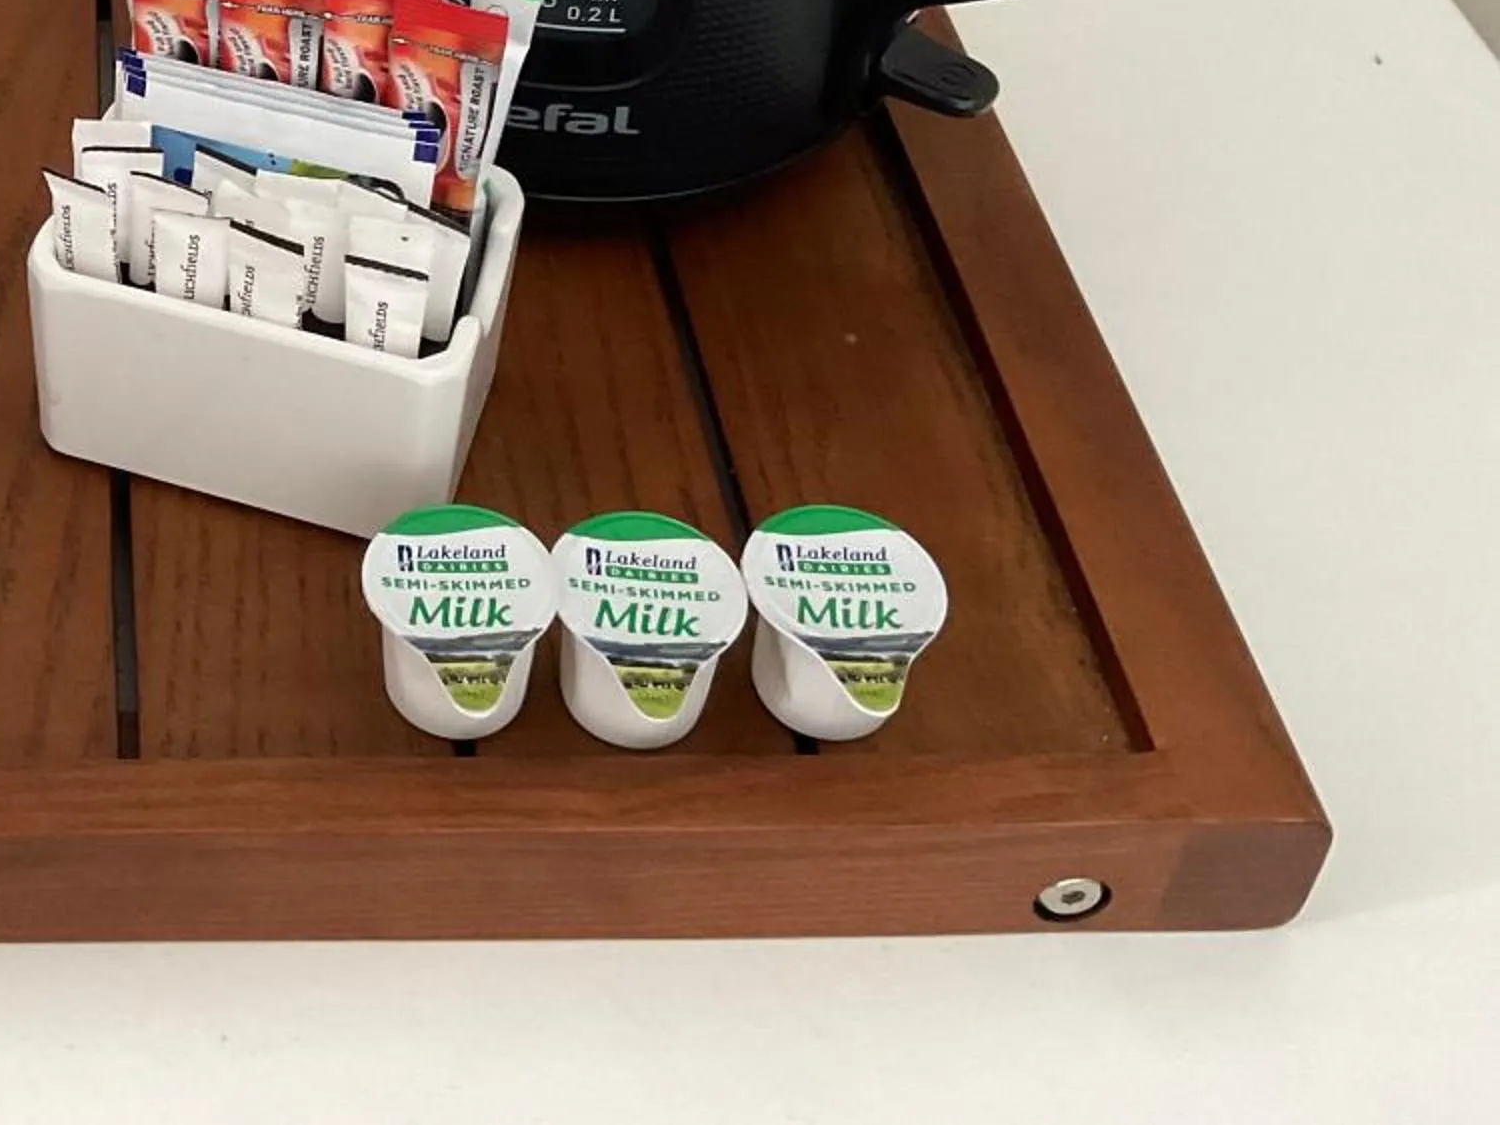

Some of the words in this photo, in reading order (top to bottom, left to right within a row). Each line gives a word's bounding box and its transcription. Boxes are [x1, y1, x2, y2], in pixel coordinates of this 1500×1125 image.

[566, 6, 602, 23] 0.2
[302, 24, 314, 62] ROAST
[471, 67, 487, 108] ROAST
[505, 103, 642, 135] efal
[417, 544, 507, 560] Lakeland
[605, 550, 698, 571] Lakeland
[796, 545, 888, 562] Lakeland
[420, 562, 505, 573] DAIRIES
[610, 567, 695, 583] DAIRIES
[802, 562, 888, 575] DAIRIES
[381, 577, 531, 591] SEMI-SKIMMED
[568, 577, 721, 602] SEMI-SKIMMED
[764, 576, 917, 593] SEMI-SKIMMED
[409, 595, 513, 628] Milk
[595, 598, 702, 637] Milk
[797, 595, 904, 629] Milk
